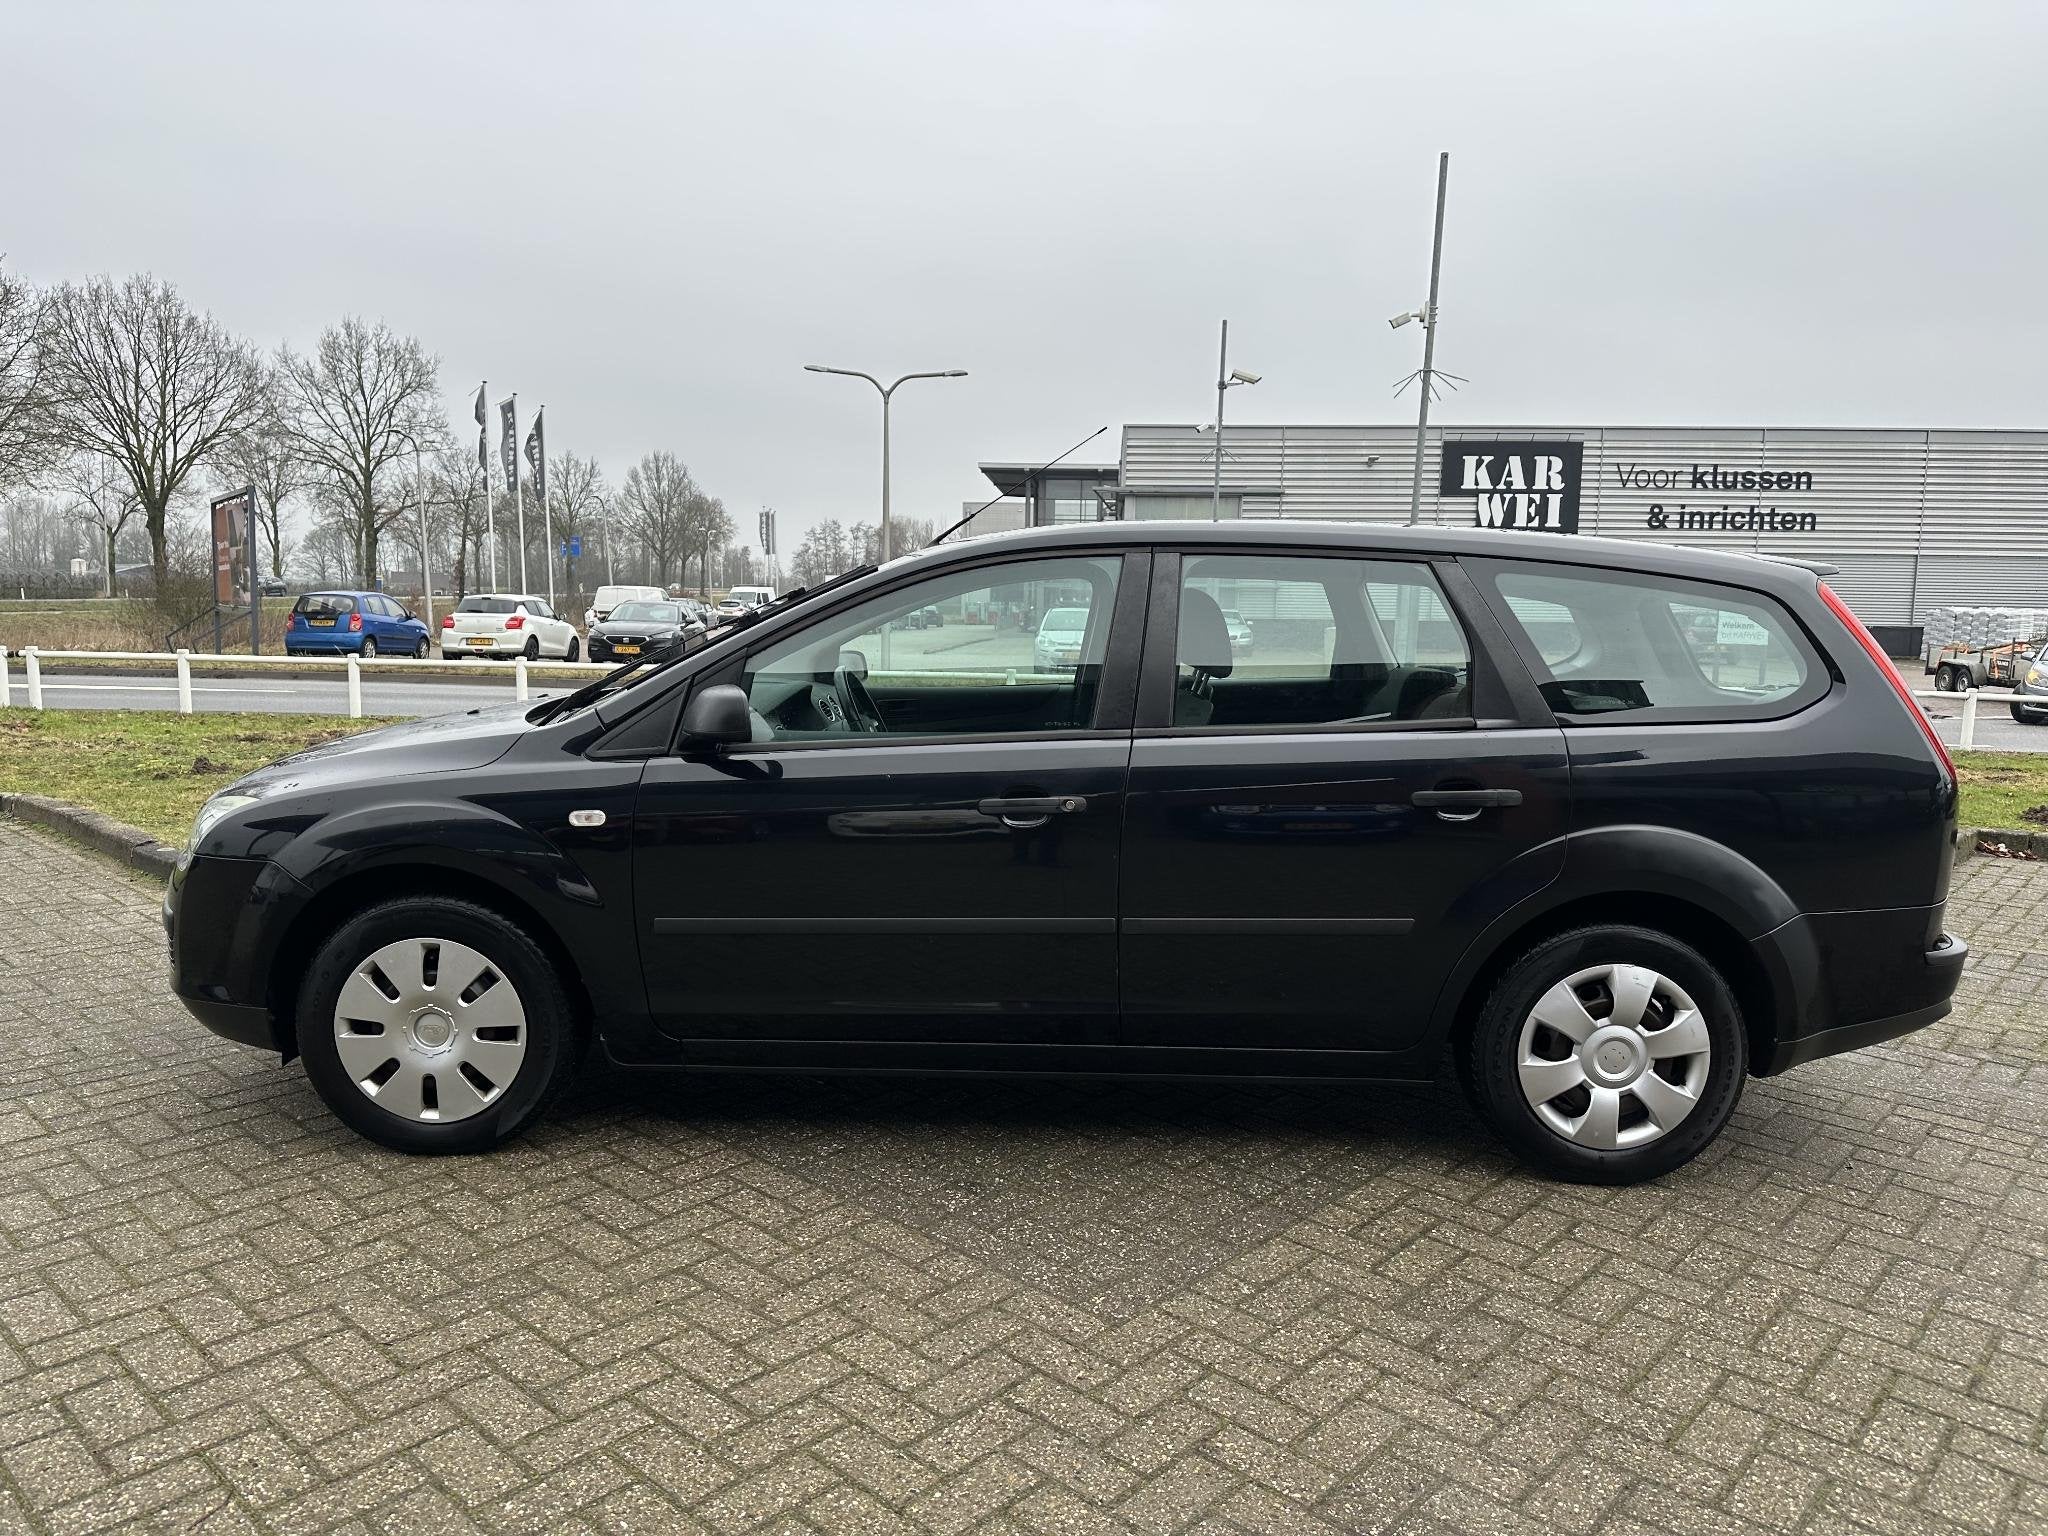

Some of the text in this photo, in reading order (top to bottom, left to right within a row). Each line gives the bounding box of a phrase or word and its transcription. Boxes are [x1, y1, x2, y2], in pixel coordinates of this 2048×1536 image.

[1460, 455, 1565, 490] KAR
[1616, 462, 1813, 490] Voor klussen
[1477, 493, 1564, 528] WEI
[1646, 503, 1817, 531] & inrichten
